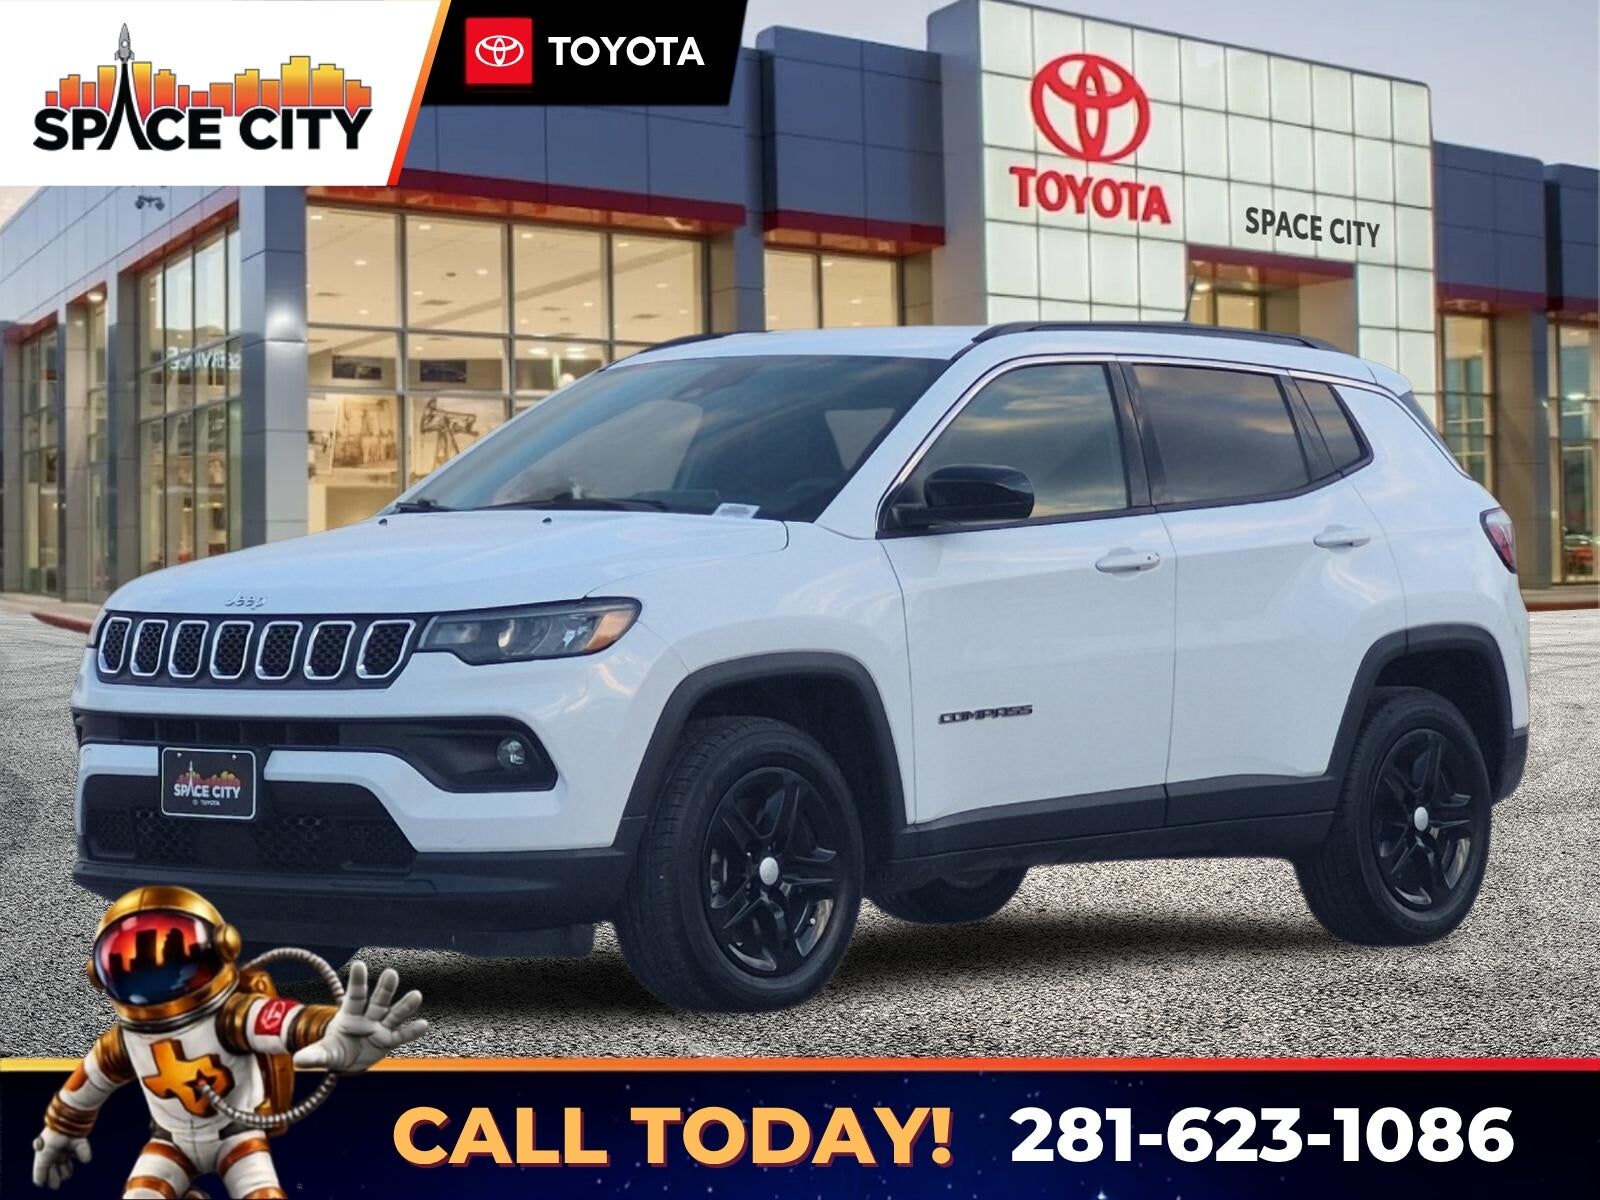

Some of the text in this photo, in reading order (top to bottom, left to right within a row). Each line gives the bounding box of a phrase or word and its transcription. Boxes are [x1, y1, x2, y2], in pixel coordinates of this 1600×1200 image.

[1009, 166, 1171, 225] TOYOTA
[1245, 206, 1381, 248] SPACE CITY
[225, 592, 266, 610] Jeep
[938, 704, 1033, 725] COMPASS
[173, 783, 241, 799] SPACE CITY
